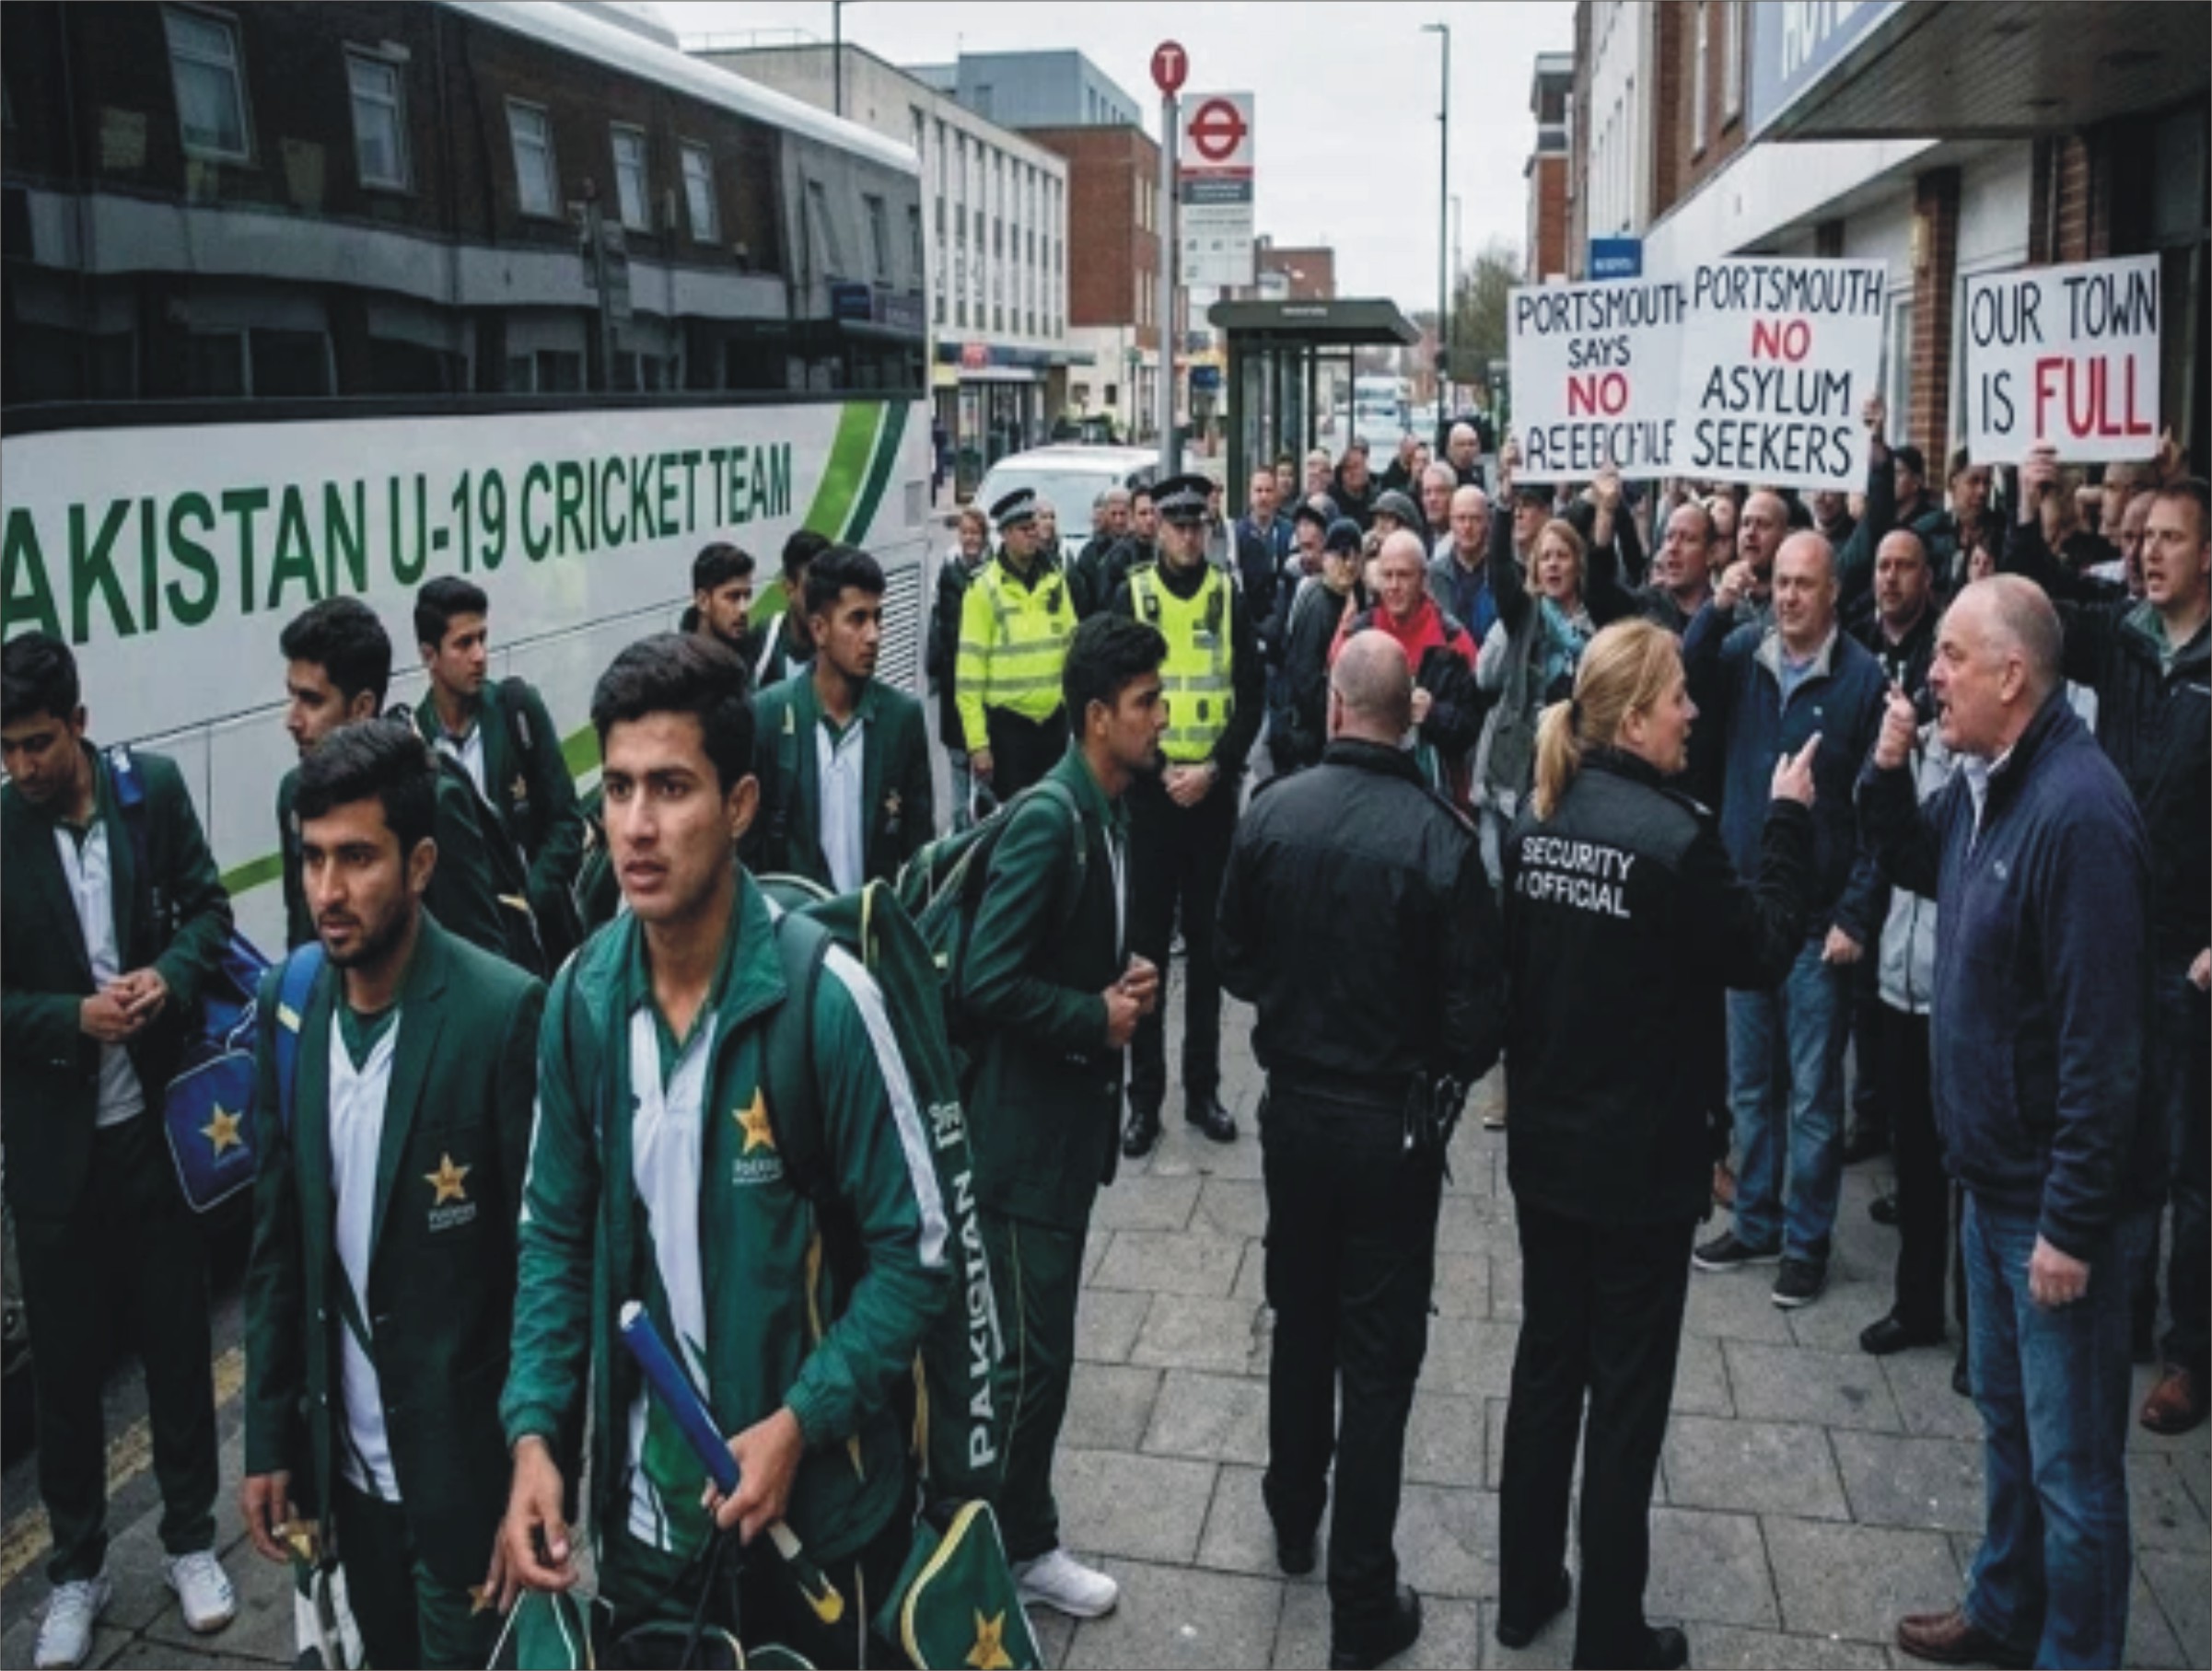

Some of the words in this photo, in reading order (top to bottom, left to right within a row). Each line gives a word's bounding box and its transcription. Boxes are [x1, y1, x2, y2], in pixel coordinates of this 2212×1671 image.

[1158, 49, 1180, 83] T
[1694, 264, 1885, 316] PORTSMOUTH
[1971, 280, 2043, 347] OUR
[2064, 269, 2157, 341] TOWN
[1567, 334, 1632, 368] SAYS
[1752, 319, 1811, 362] NO
[1566, 372, 1628, 416] NO
[1701, 366, 1853, 416] ASYLUM
[1982, 371, 2015, 435] IS
[2035, 354, 2153, 439] FULL
[1691, 418, 1853, 478] SEEKERS
[390, 468, 506, 586] U-19
[519, 448, 703, 563] CRICKET
[708, 442, 791, 528] TEAM
[1521, 835, 1636, 882] SECURITY
[1526, 870, 1632, 919] OFFICIAL
